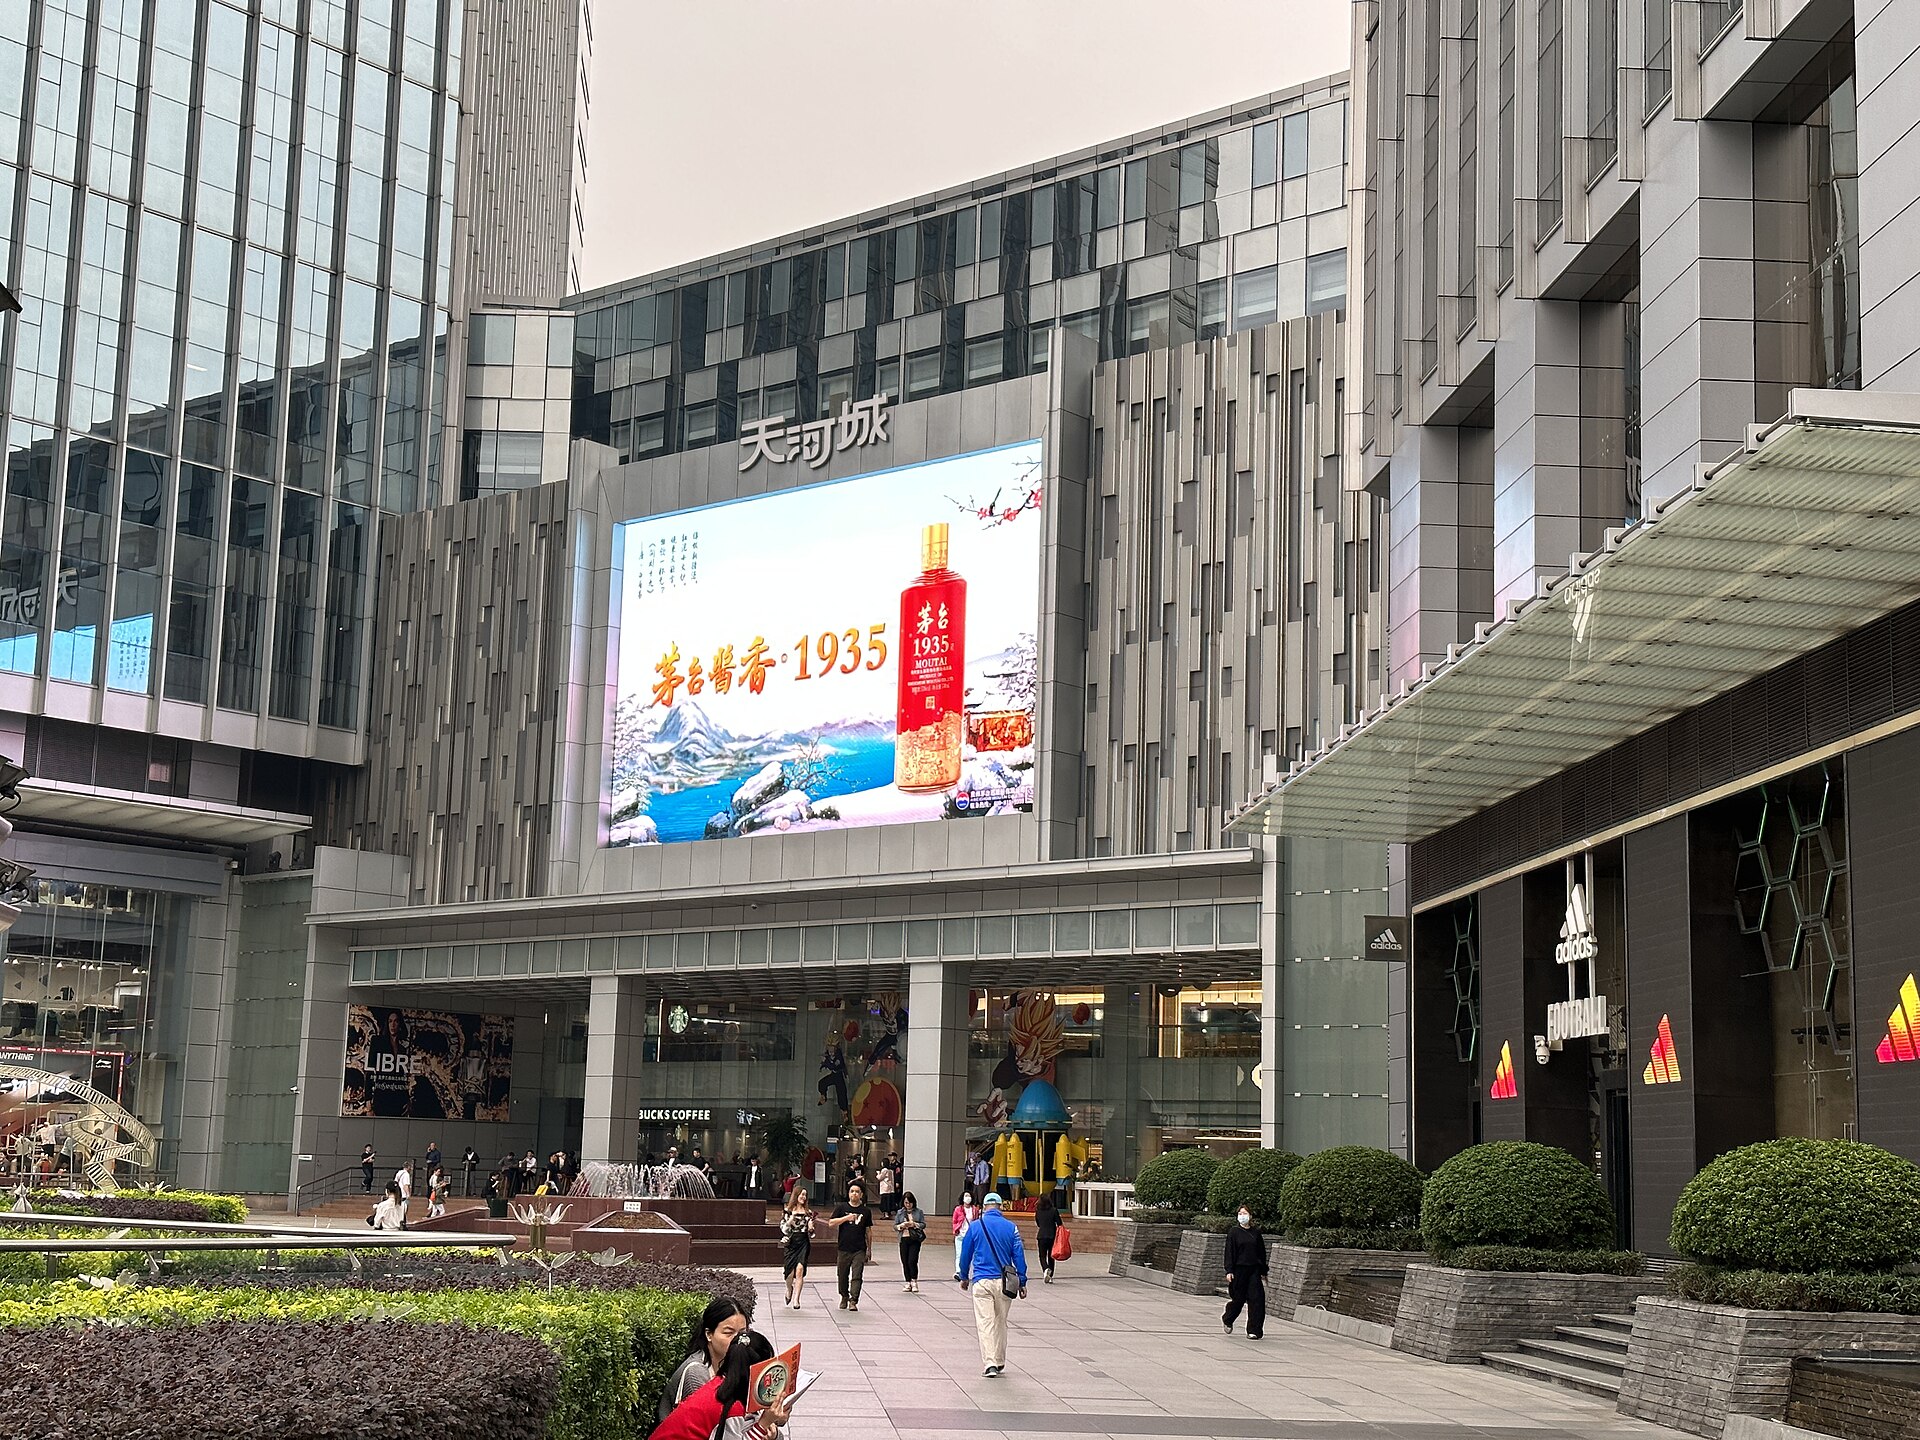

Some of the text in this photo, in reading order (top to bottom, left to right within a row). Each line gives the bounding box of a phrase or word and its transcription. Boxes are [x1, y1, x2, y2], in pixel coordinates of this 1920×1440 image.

[739, 393, 888, 470] 天河城
[916, 600, 949, 634] 茅台
[913, 635, 949, 658] 1935
[915, 657, 948, 669] MOUTAI
[1370, 941, 1402, 950] adidas
[1555, 930, 1598, 965] adidas
[1548, 995, 1610, 1042] FOOTBALL
[364, 1050, 421, 1074] LIBRE
[672, 1109, 711, 1120] COFFEE
